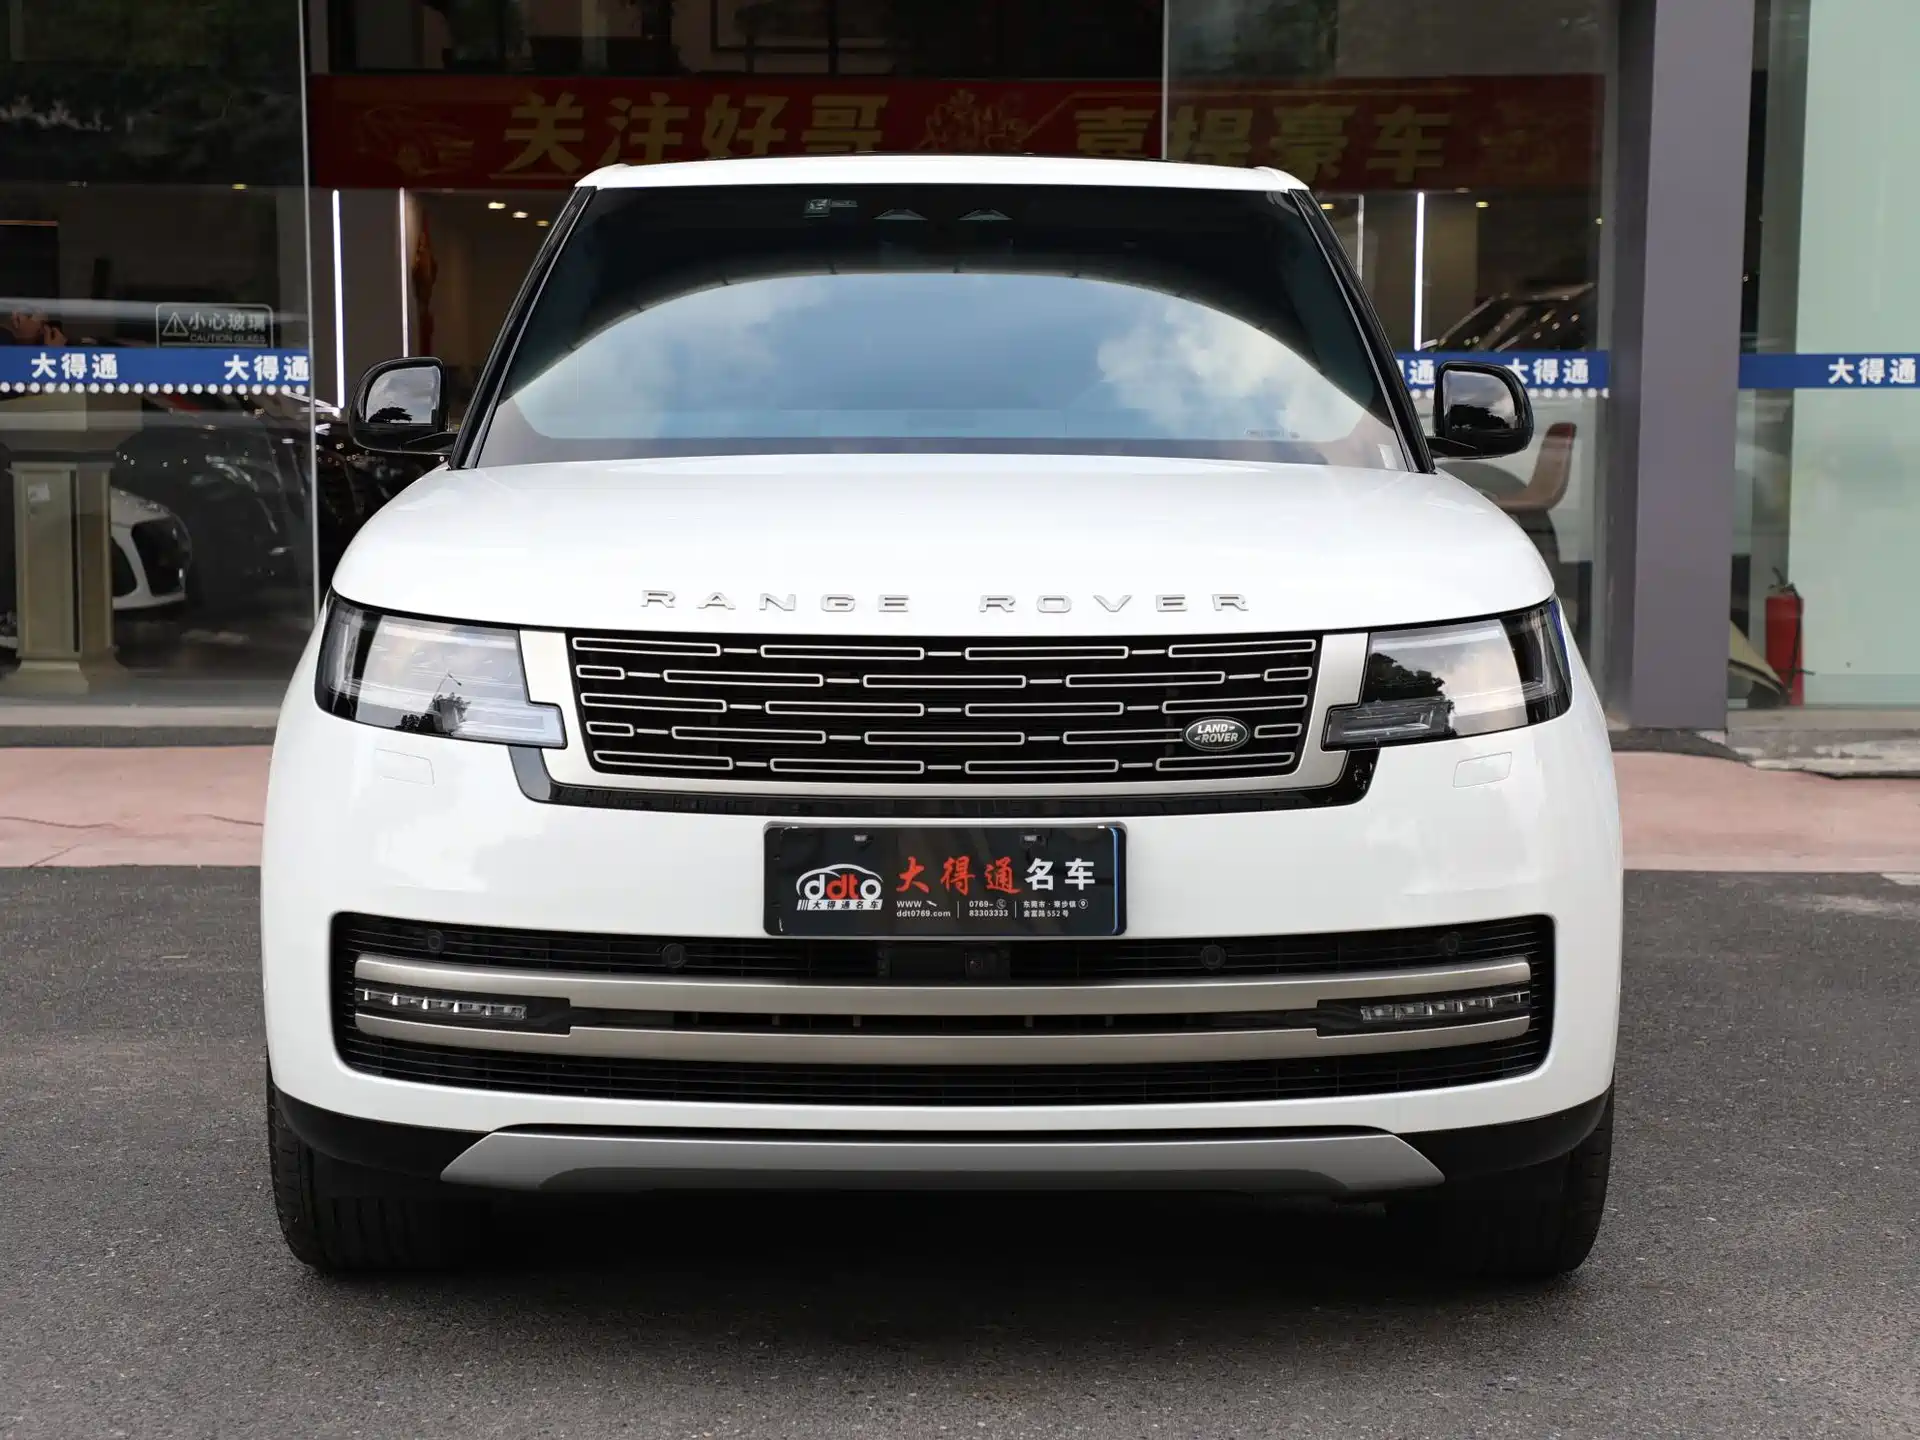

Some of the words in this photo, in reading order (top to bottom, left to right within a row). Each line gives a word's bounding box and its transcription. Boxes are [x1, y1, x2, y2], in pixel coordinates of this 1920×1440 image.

[500, 90, 889, 174] 关注好哥
[189, 311, 265, 332] 小心玻璃
[190, 334, 233, 342] CAUTION
[31, 352, 118, 379] 大得通
[224, 354, 310, 381] 大得通
[1504, 357, 1589, 385] 大得通
[1827, 357, 1916, 385] 大得通
[641, 590, 910, 612] RANGE
[979, 594, 1249, 613] ROVER
[1197, 723, 1228, 734] LAND
[1201, 732, 1238, 744] ROVER
[896, 855, 1096, 897] 大得通名车
[812, 900, 879, 910] 大得通名车
[896, 909, 951, 918] ddt0769.com
[969, 909, 1009, 917] 83303333
